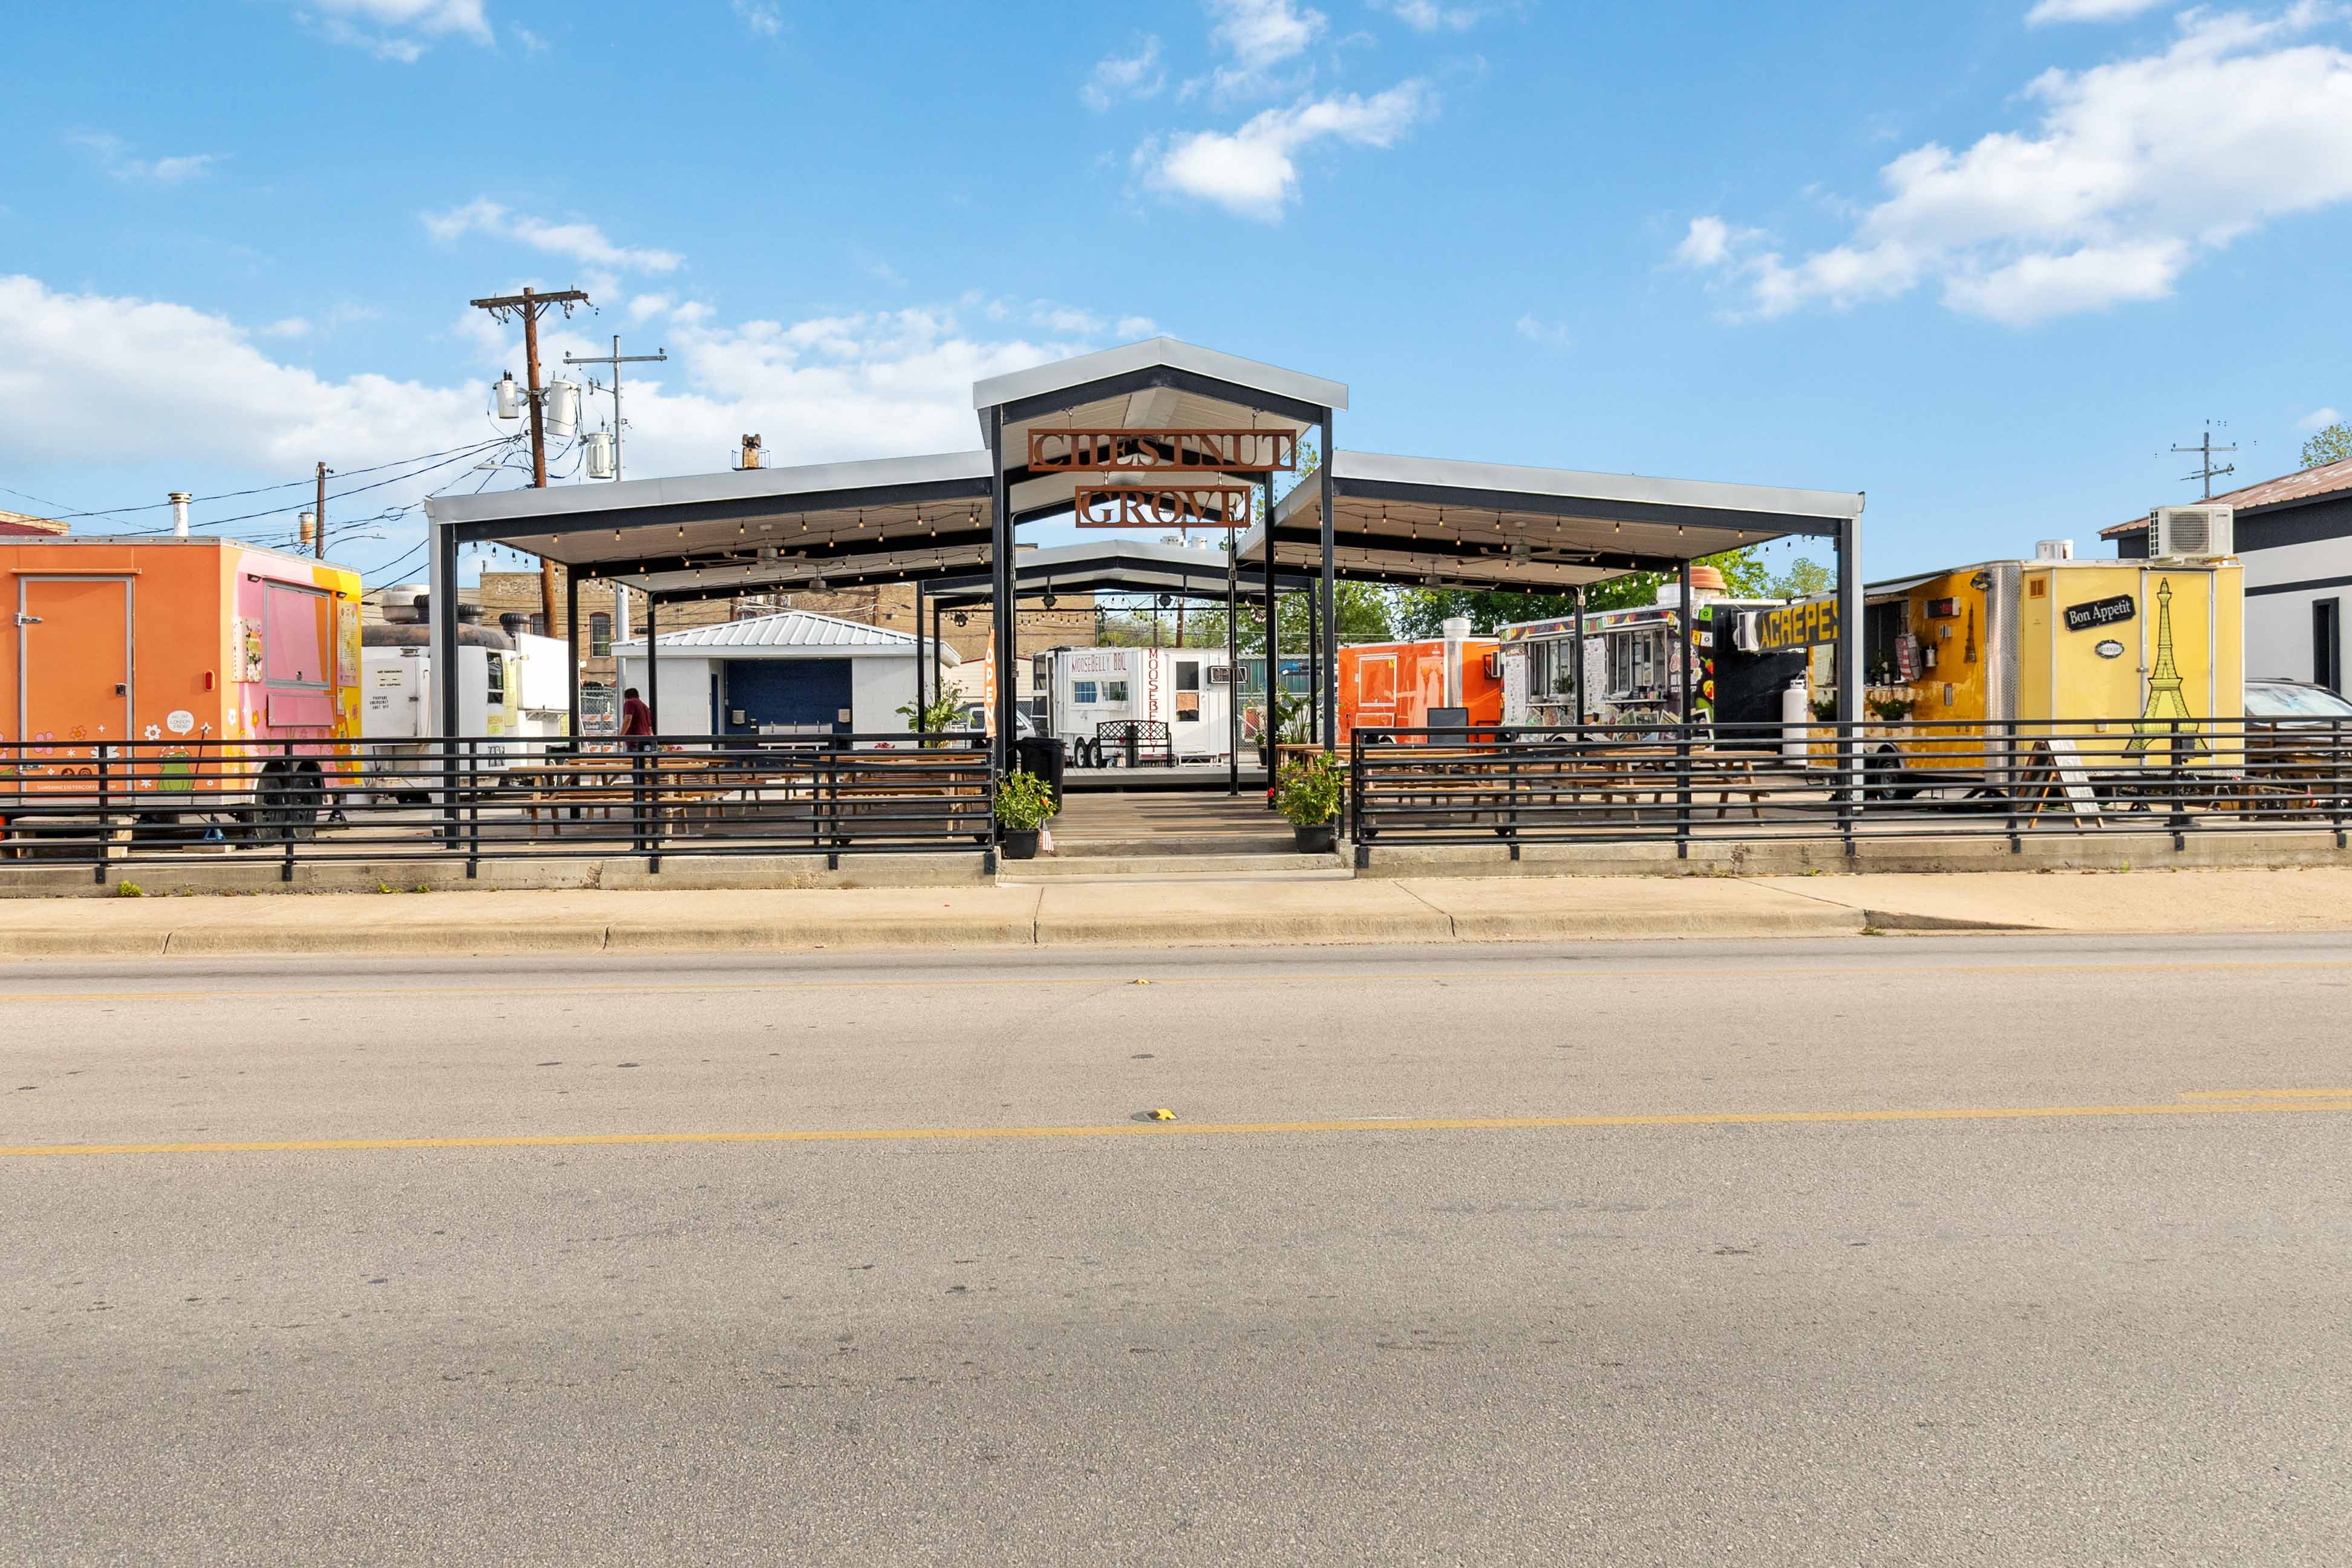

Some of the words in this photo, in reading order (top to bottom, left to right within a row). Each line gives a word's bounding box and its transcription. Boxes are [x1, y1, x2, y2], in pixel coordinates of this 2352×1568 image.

[1033, 434, 1290, 466] CHESTNUT
[1080, 491, 1246, 523] GROVE
[2069, 610, 2091, 624] Bon
[2092, 599, 2131, 621] Appetit
[985, 647, 995, 722] OPEN
